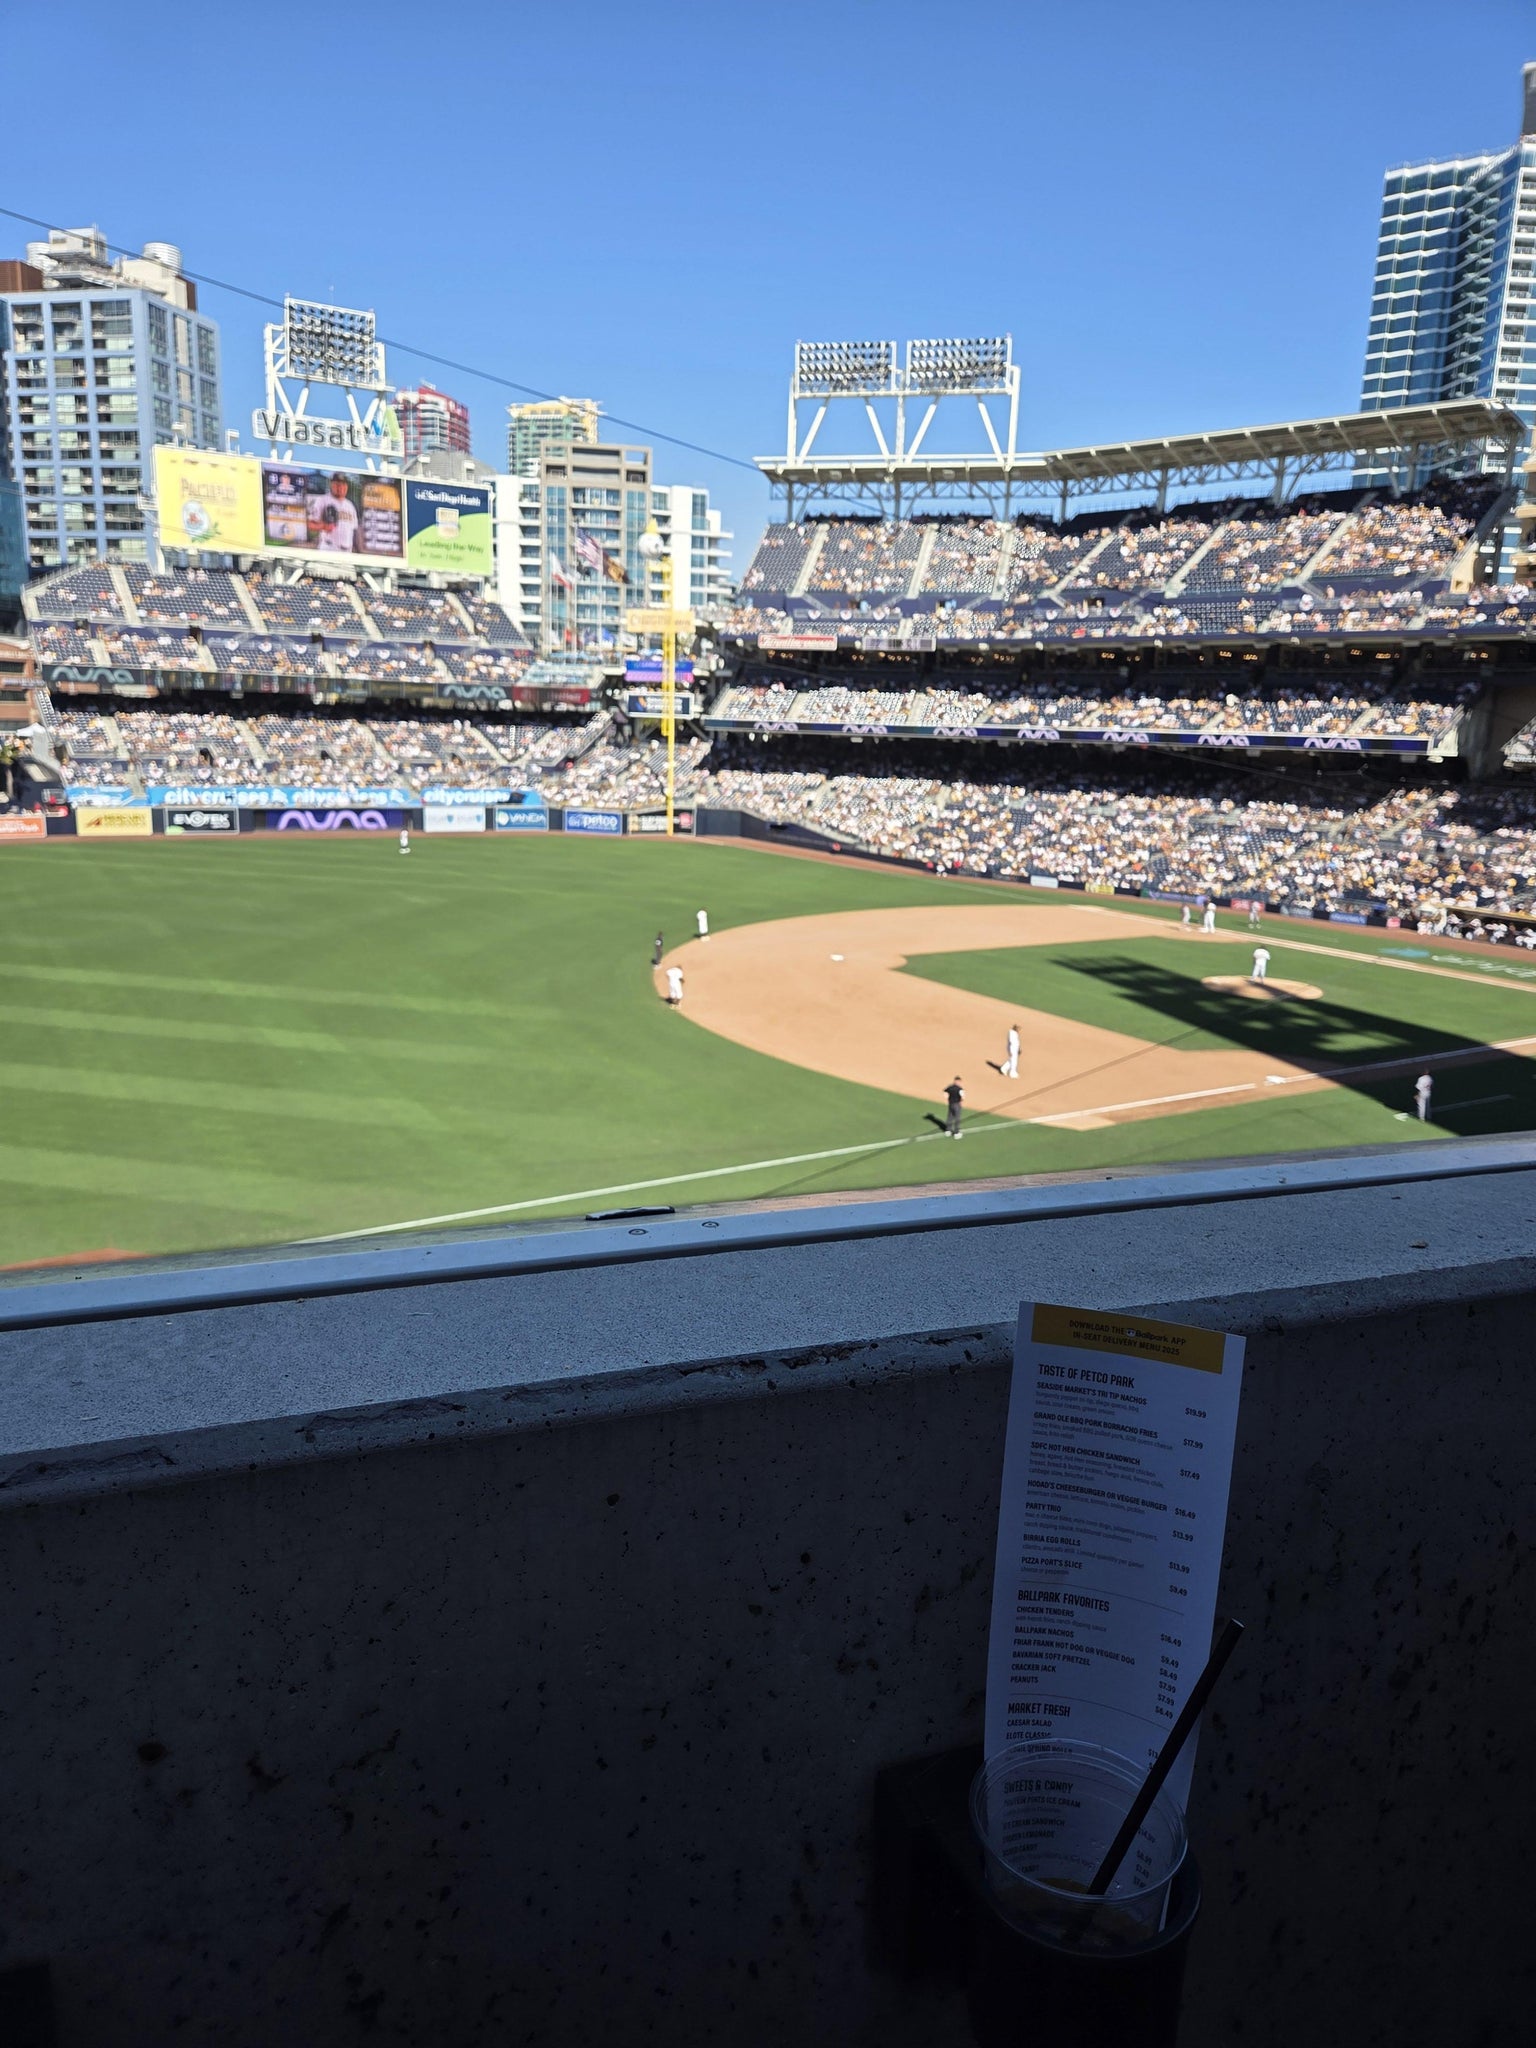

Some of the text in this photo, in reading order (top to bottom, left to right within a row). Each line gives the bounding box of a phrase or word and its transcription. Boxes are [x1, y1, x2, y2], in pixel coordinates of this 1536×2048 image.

[262, 411, 359, 447] Viasat
[51, 666, 135, 683] nuna
[443, 684, 507, 699] nuna
[276, 809, 388, 830] nuna
[1069, 1320, 1187, 1346] DOWNLOAD THE Ballpark APP
[1072, 1332, 1180, 1355] IN-SEAT DELIVERY MENU 2025
[1039, 1364, 1134, 1388] TASTE OF PETCO PARK
[1037, 1382, 1063, 1392] SEASIDE
[1064, 1385, 1097, 1396] MARKET'S
[1120, 1394, 1147, 1405] NACHOS
[1185, 1407, 1207, 1418] $19.99
[1034, 1412, 1158, 1438] GRAND OLE BBQ PORK BORRACHO FRIES
[1183, 1439, 1203, 1449] $17.99
[1031, 1441, 1140, 1465] SDFC HOT HEN CHICKEN SANDWICH
[1180, 1469, 1200, 1480] $17.49
[1028, 1480, 1055, 1489] HODAD'S
[1056, 1484, 1105, 1498] CHEESEBURGER
[1117, 1493, 1140, 1505] VEGGIE
[1141, 1499, 1167, 1512] BURGER
[1026, 1502, 1061, 1512] PARTY TRIO
[1175, 1508, 1196, 1519] $16.49
[1023, 1534, 1045, 1543] BIRRIA
[1060, 1538, 1081, 1546] ROLLS
[1172, 1530, 1193, 1542] $13.99
[1041, 1559, 1063, 1567] PORT'S
[1064, 1561, 1082, 1569] SLICE
[1169, 1562, 1190, 1573] $13.99
[1018, 1590, 1109, 1612] BALLPARK FAVORITES
[1017, 1606, 1074, 1617] CHICKEN TENDERS
[1015, 1626, 1074, 1638] BALLPARK NACHOS
[1013, 1651, 1091, 1666] BAVARIAN SOFT PRETZEL
[1033, 1640, 1054, 1648] FRANK
[1070, 1644, 1084, 1652] DOG
[1085, 1646, 1095, 1654] OR
[1096, 1648, 1120, 1660] VEGGIE
[1121, 1655, 1135, 1665] DOG
[1008, 1703, 1070, 1717] MARKET FRESH
[1004, 1780, 1033, 1793] SWEETS
[1044, 1780, 1074, 1794] CANDY
